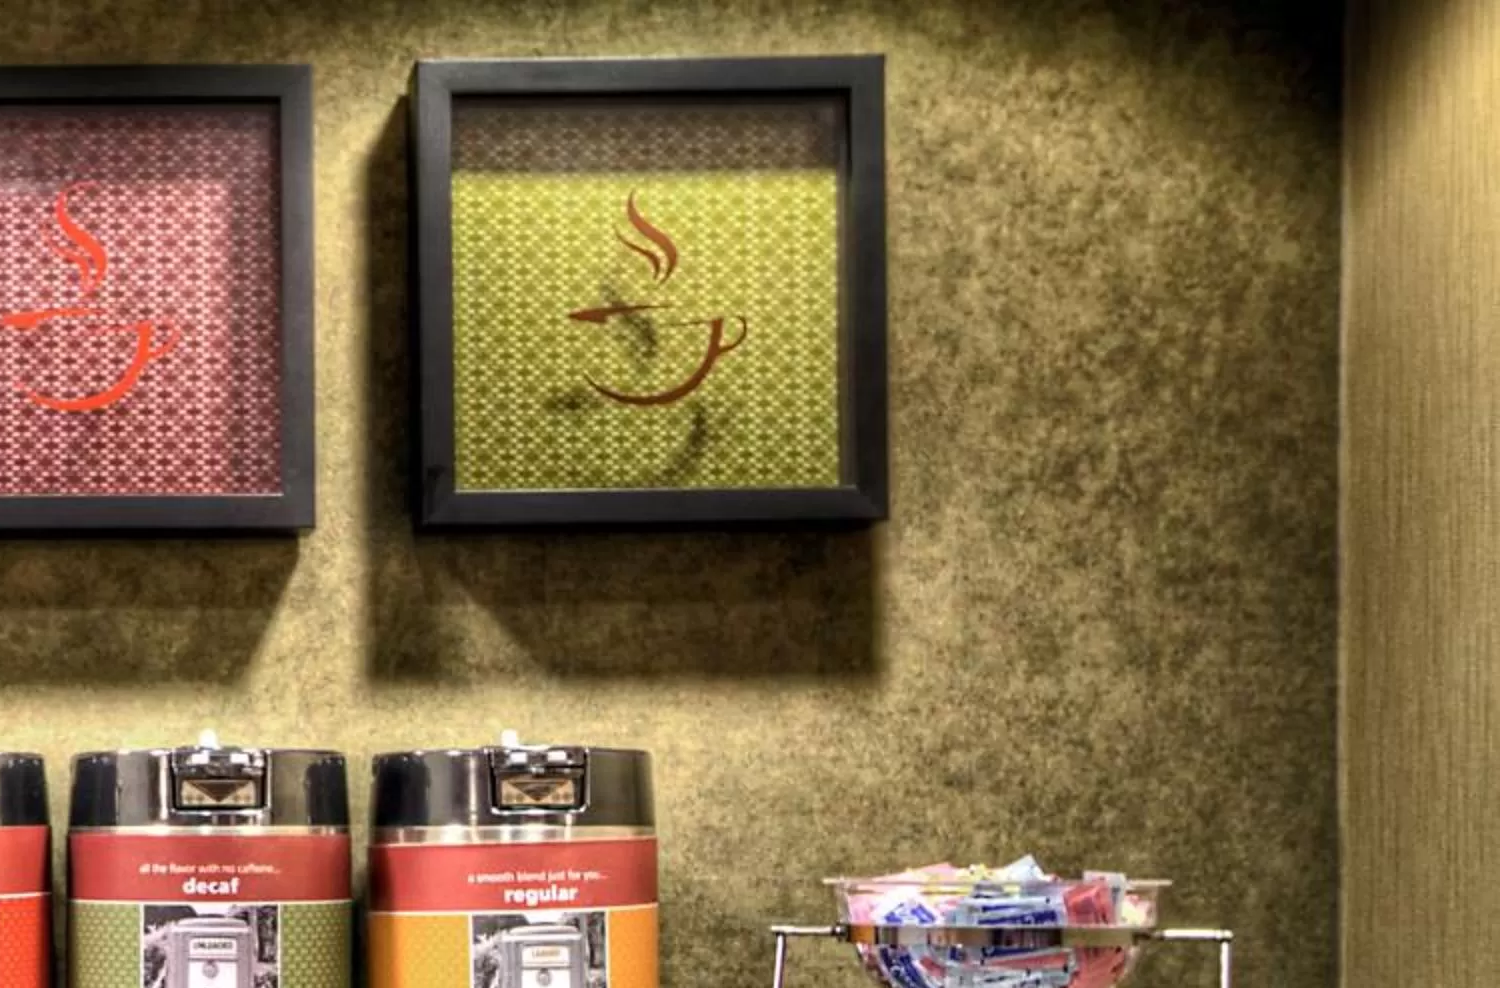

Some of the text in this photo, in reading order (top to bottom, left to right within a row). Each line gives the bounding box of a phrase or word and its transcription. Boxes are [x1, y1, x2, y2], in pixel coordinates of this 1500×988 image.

[152, 863, 167, 873] the
[169, 862, 196, 873] flavor
[198, 862, 220, 873] with
[222, 864, 236, 873] no
[477, 871, 514, 883] smooth
[517, 870, 546, 881] blend
[567, 868, 581, 879] for
[182, 877, 240, 894] decaf
[503, 884, 579, 906] regular
